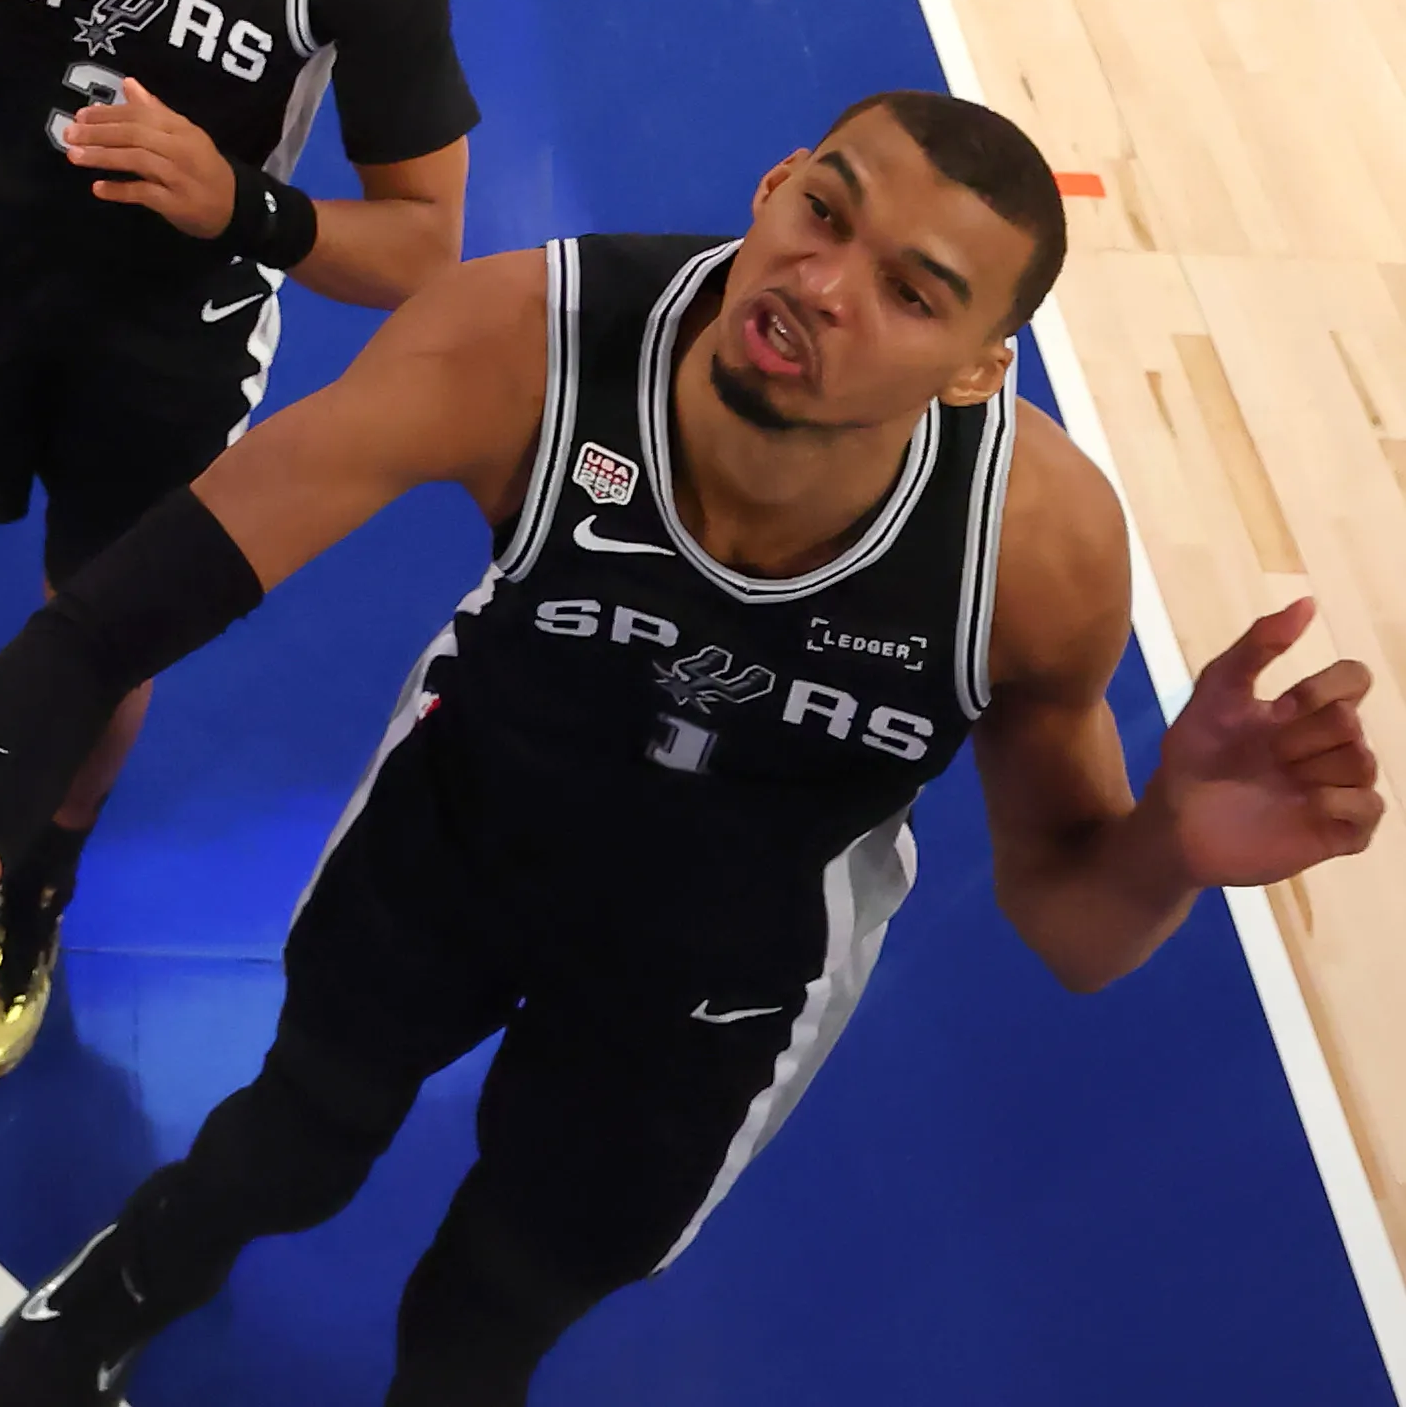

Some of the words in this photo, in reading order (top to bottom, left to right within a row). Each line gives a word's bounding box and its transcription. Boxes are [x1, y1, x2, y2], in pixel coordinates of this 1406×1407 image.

[823, 630, 910, 660] LEDGER
[534, 599, 934, 761] SPURS
[645, 712, 718, 774] 1
